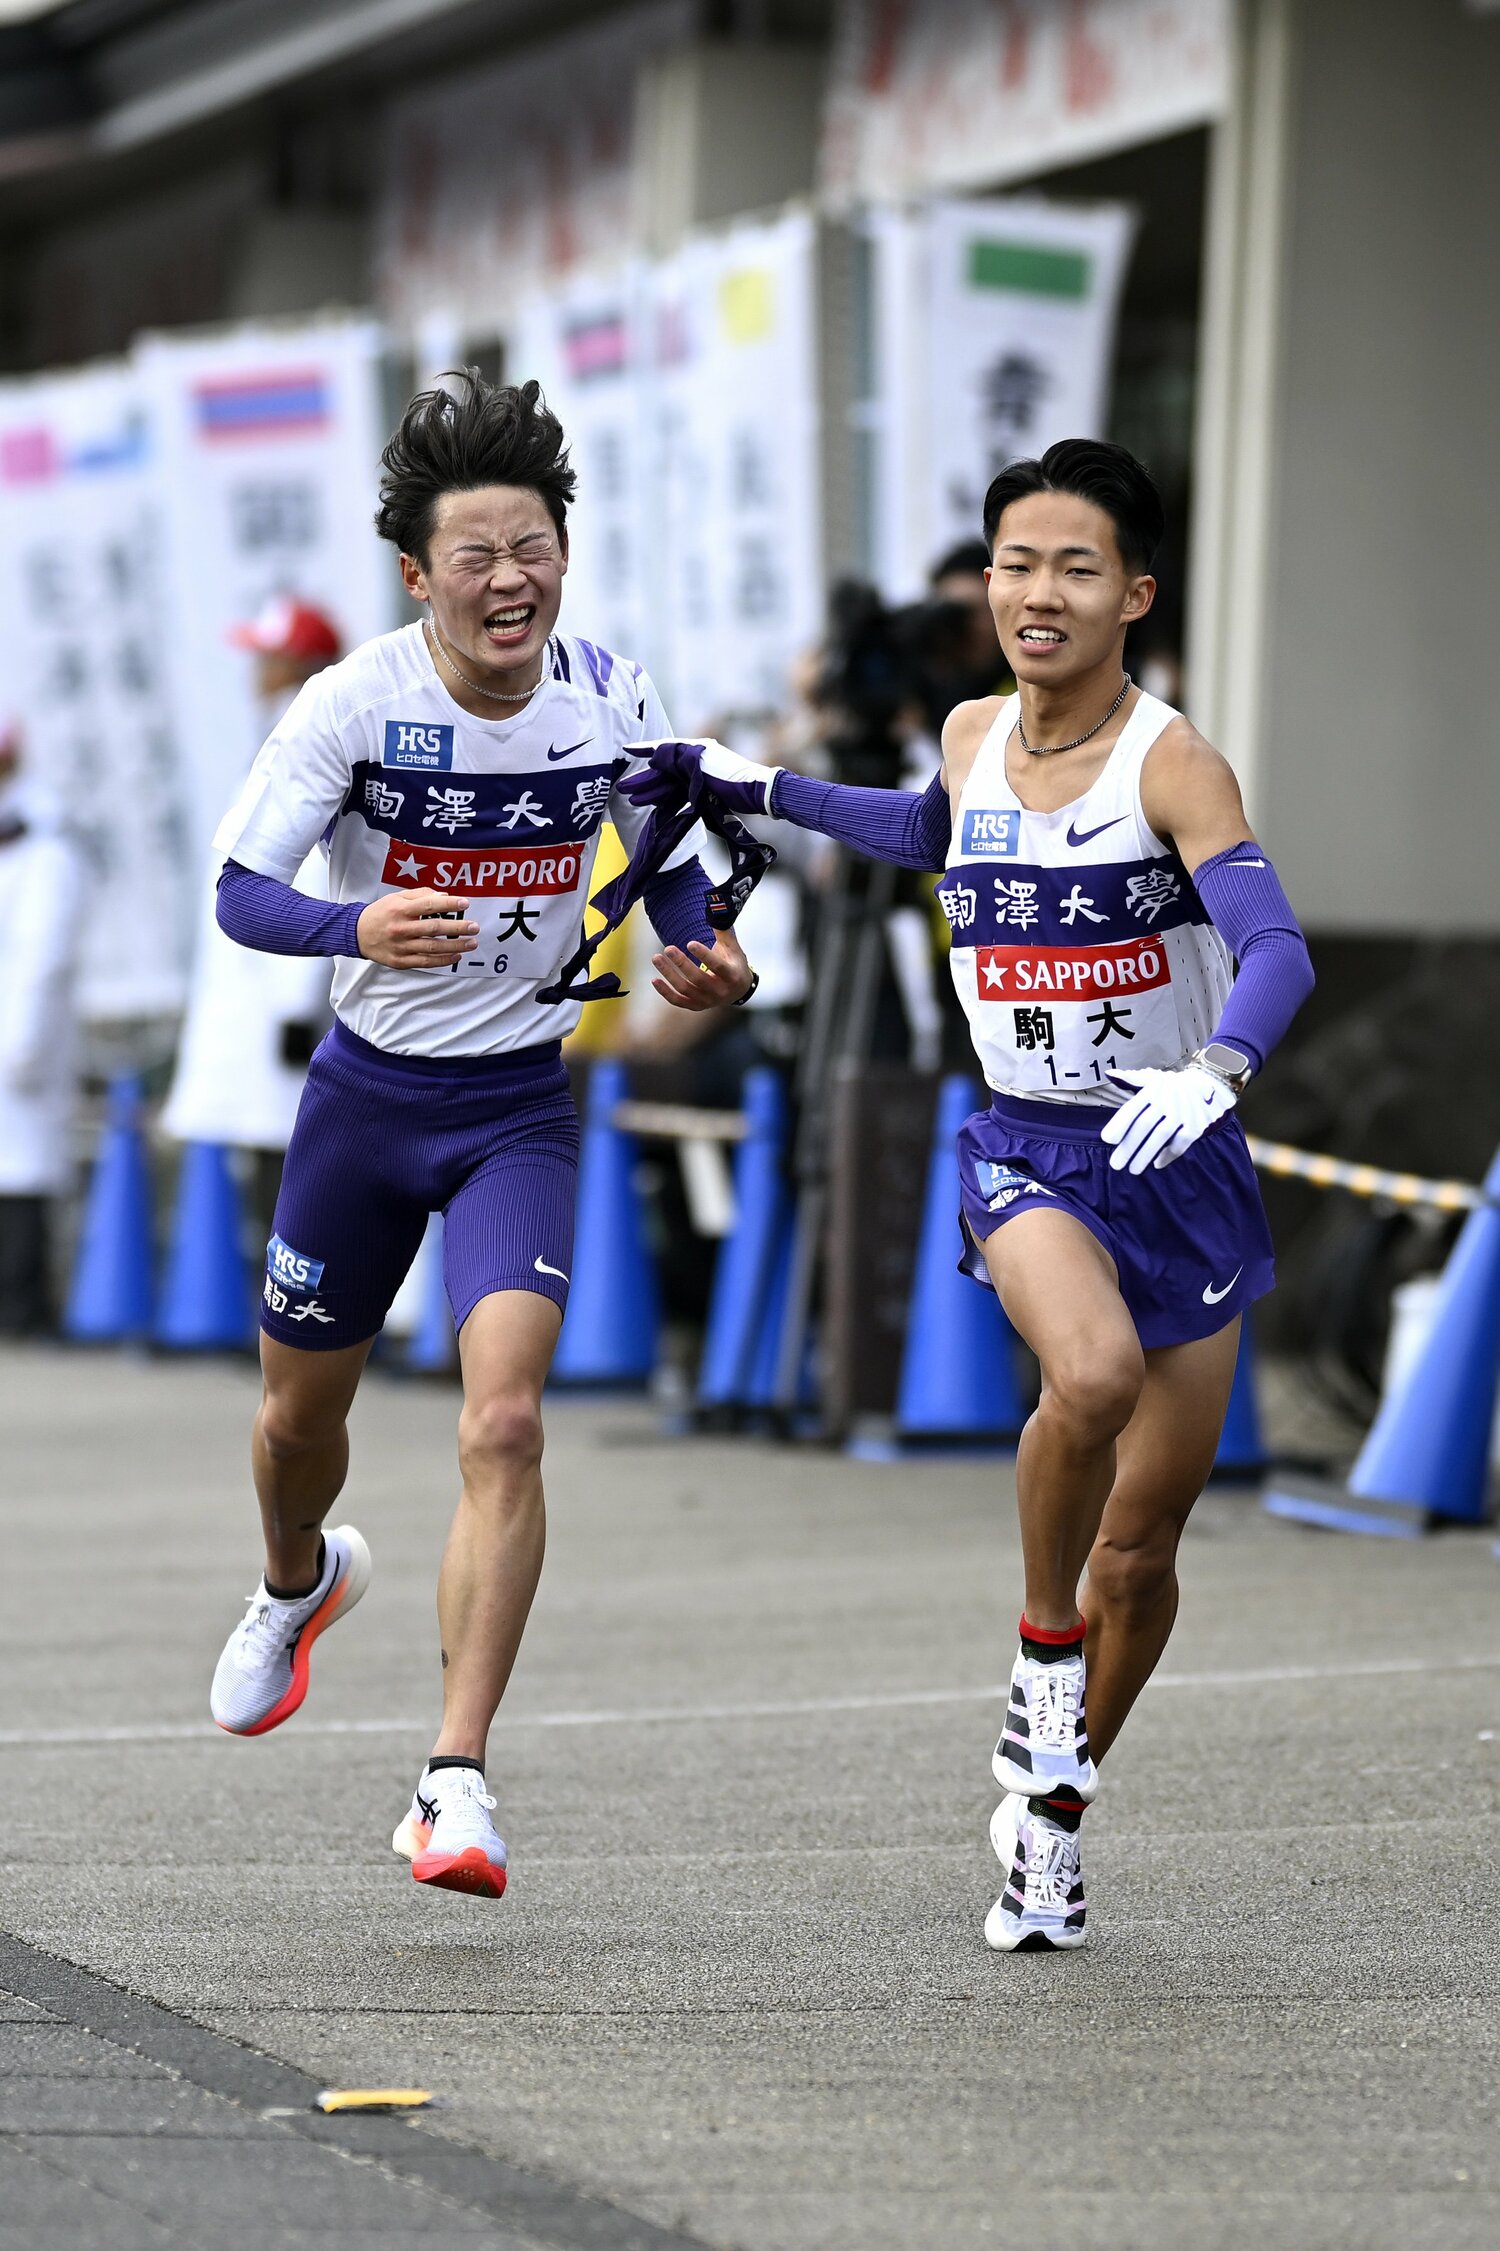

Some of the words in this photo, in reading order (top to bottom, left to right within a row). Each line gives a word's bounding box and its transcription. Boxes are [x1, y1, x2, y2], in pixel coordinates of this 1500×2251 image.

[397, 726, 441, 753] HRS
[396, 752, 440, 766] ヒロセ電機
[971, 814, 1011, 839] HRS
[433, 856, 576, 887] SAPPORO
[1015, 950, 1160, 990] SAPPORO
[1013, 1001, 1136, 1051] 駒大
[274, 1244, 311, 1283] HRS
[263, 1273, 336, 1324] 駒大
